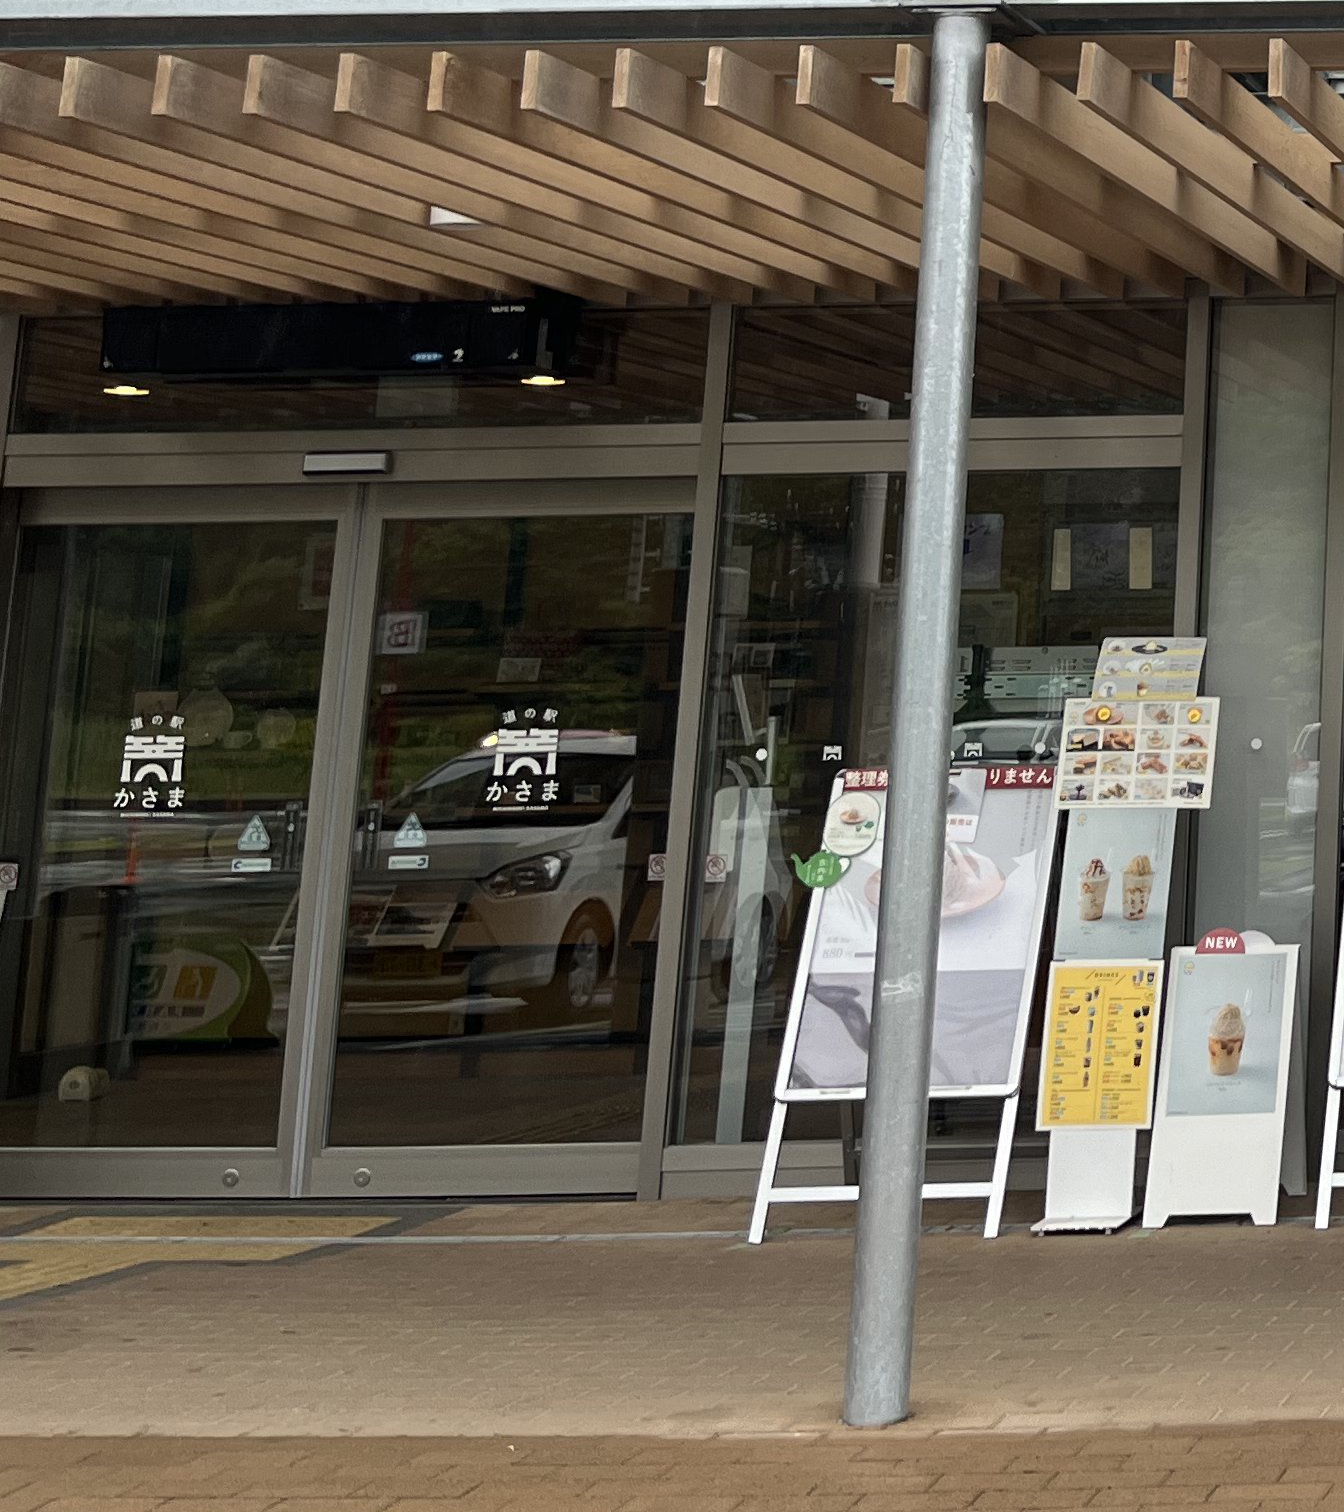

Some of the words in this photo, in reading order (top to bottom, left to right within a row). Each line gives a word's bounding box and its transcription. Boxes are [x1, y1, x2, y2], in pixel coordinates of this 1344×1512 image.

[130, 715, 185, 731] 道の駅
[502, 708, 558, 724] 道の駅
[989, 768, 1052, 785] りません
[113, 786, 185, 808] かさま
[486, 780, 559, 802] かさま
[1205, 937, 1238, 949] NEW
